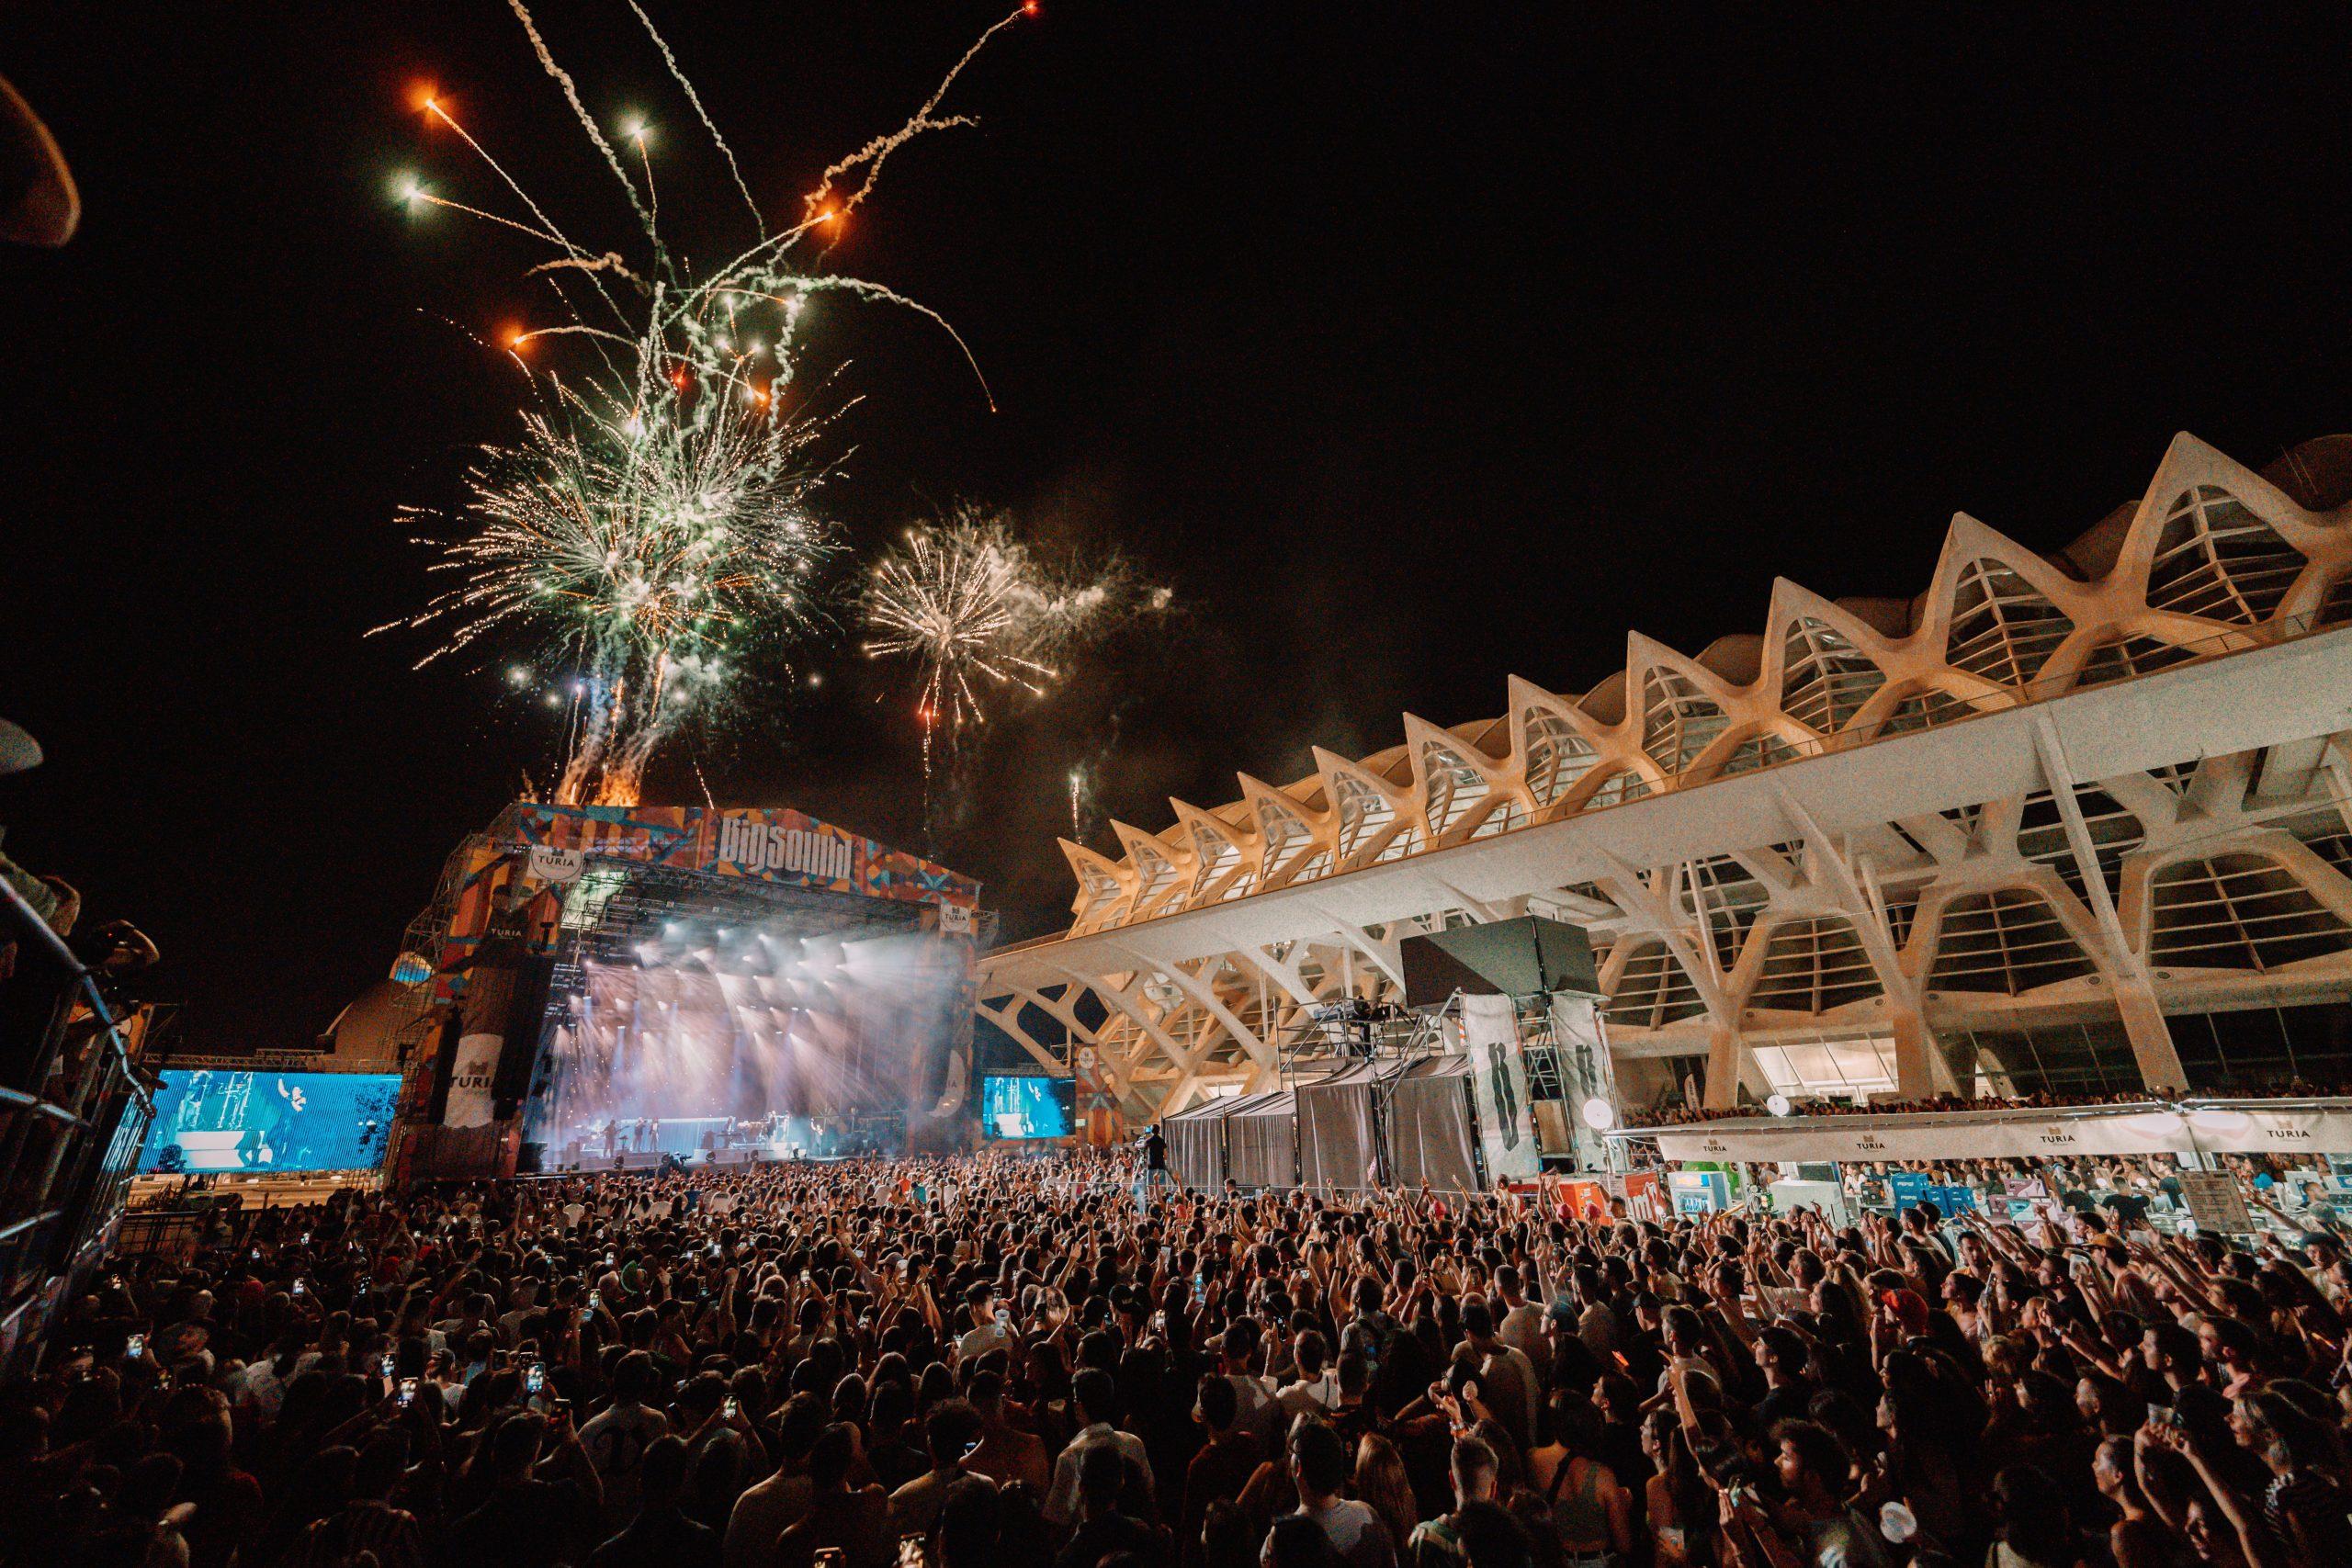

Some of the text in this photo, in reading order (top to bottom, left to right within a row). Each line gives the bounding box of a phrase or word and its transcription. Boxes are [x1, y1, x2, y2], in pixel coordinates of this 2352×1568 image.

[537, 855, 575, 868] TURIA
[944, 913, 967, 921] TURIA
[491, 928, 522, 937] TURIA
[448, 1076, 494, 1089] TURI
[2040, 1134, 2076, 1143] TURIA
[2266, 1130, 2312, 1138] TURIA
